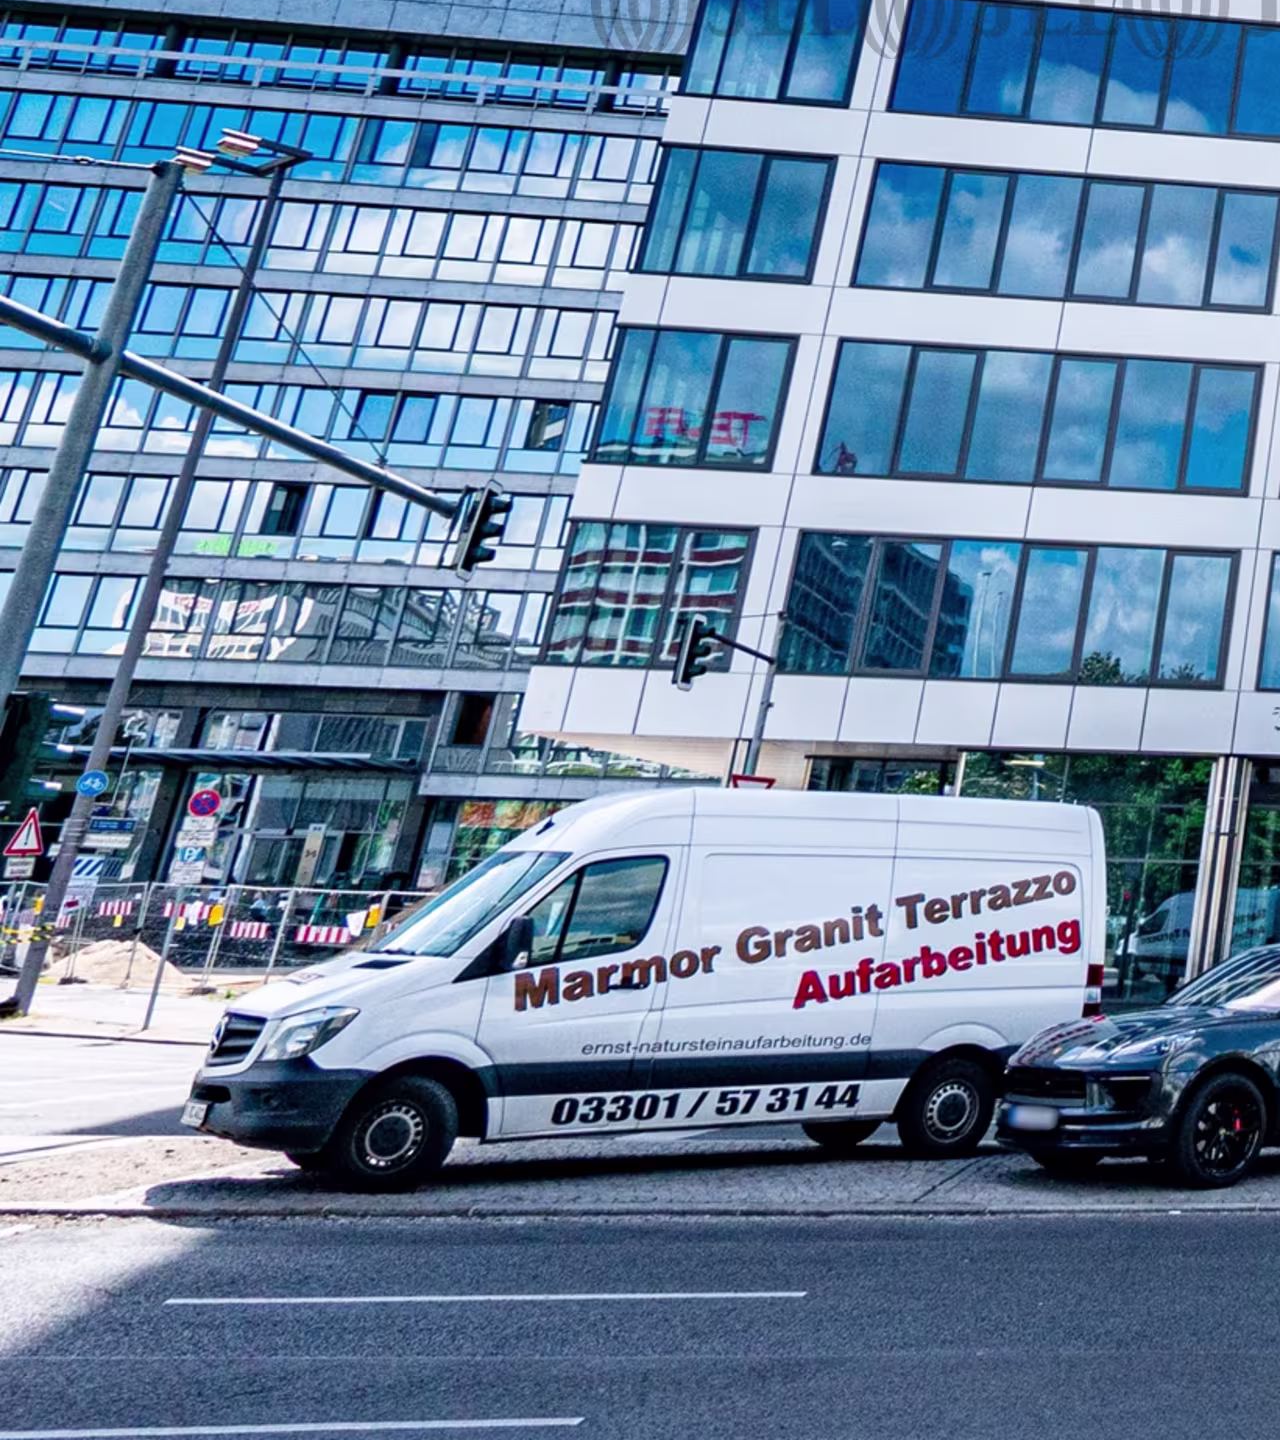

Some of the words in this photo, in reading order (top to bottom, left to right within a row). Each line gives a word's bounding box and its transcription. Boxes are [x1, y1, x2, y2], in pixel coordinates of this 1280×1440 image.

[513, 945, 721, 1012] Marmor
[736, 904, 884, 964] Granit
[895, 870, 1076, 930] Terrazzo
[792, 919, 1082, 1009] Aufarbeitung
[581, 1032, 872, 1056] ernst-natursteinaufarbeitung.de
[551, 1093, 681, 1126] 03301
[686, 1090, 709, 1118] /
